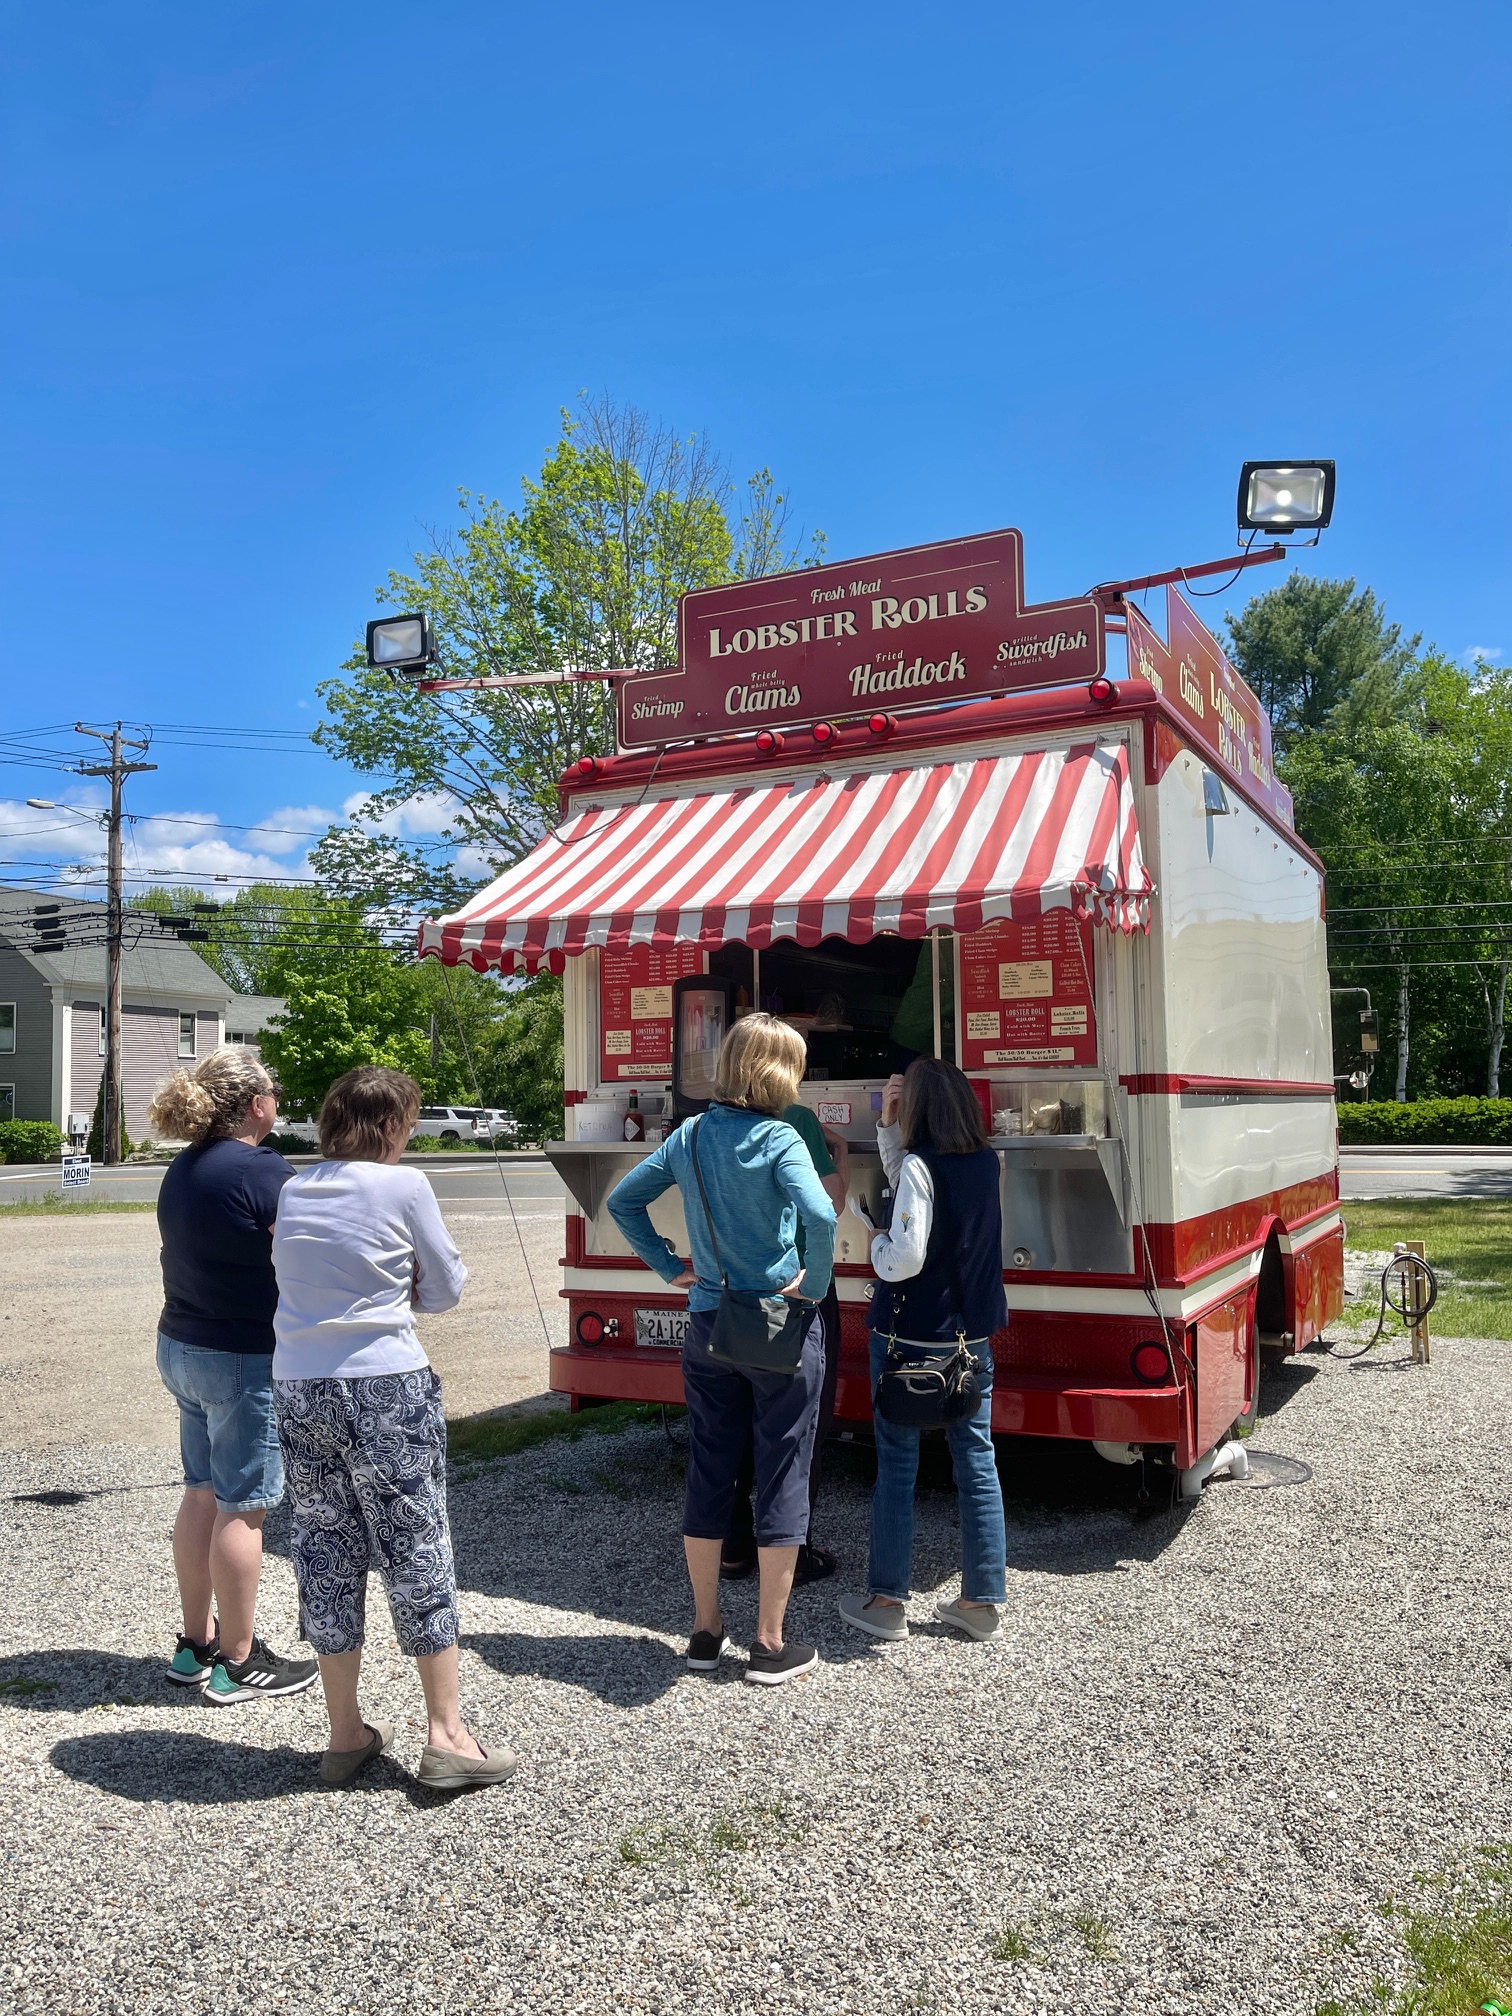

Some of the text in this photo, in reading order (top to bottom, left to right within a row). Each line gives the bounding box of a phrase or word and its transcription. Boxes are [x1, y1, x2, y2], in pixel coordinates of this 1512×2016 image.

[810, 578, 882, 605] Fresh Meat
[709, 585, 988, 658] LOBSTER ROLLS
[996, 630, 1088, 662] Swordfish
[1013, 634, 1038, 645] grilled
[875, 650, 904, 663] Fried
[1009, 656, 1042, 667] sandwich
[751, 669, 778, 682] Fried
[848, 651, 967, 697] Haddock
[724, 684, 802, 716] Clams
[1179, 661, 1204, 720] Clams
[631, 700, 685, 720] Shrimp
[1210, 671, 1247, 747] LOBSTER
[1217, 720, 1243, 777] ROLLS
[1005, 1007, 1045, 1017] LOBSTER ROLL
[822, 1105, 844, 1115] CASH
[825, 1114, 843, 1123] ONLY
[64, 1167, 89, 1179] MORIN
